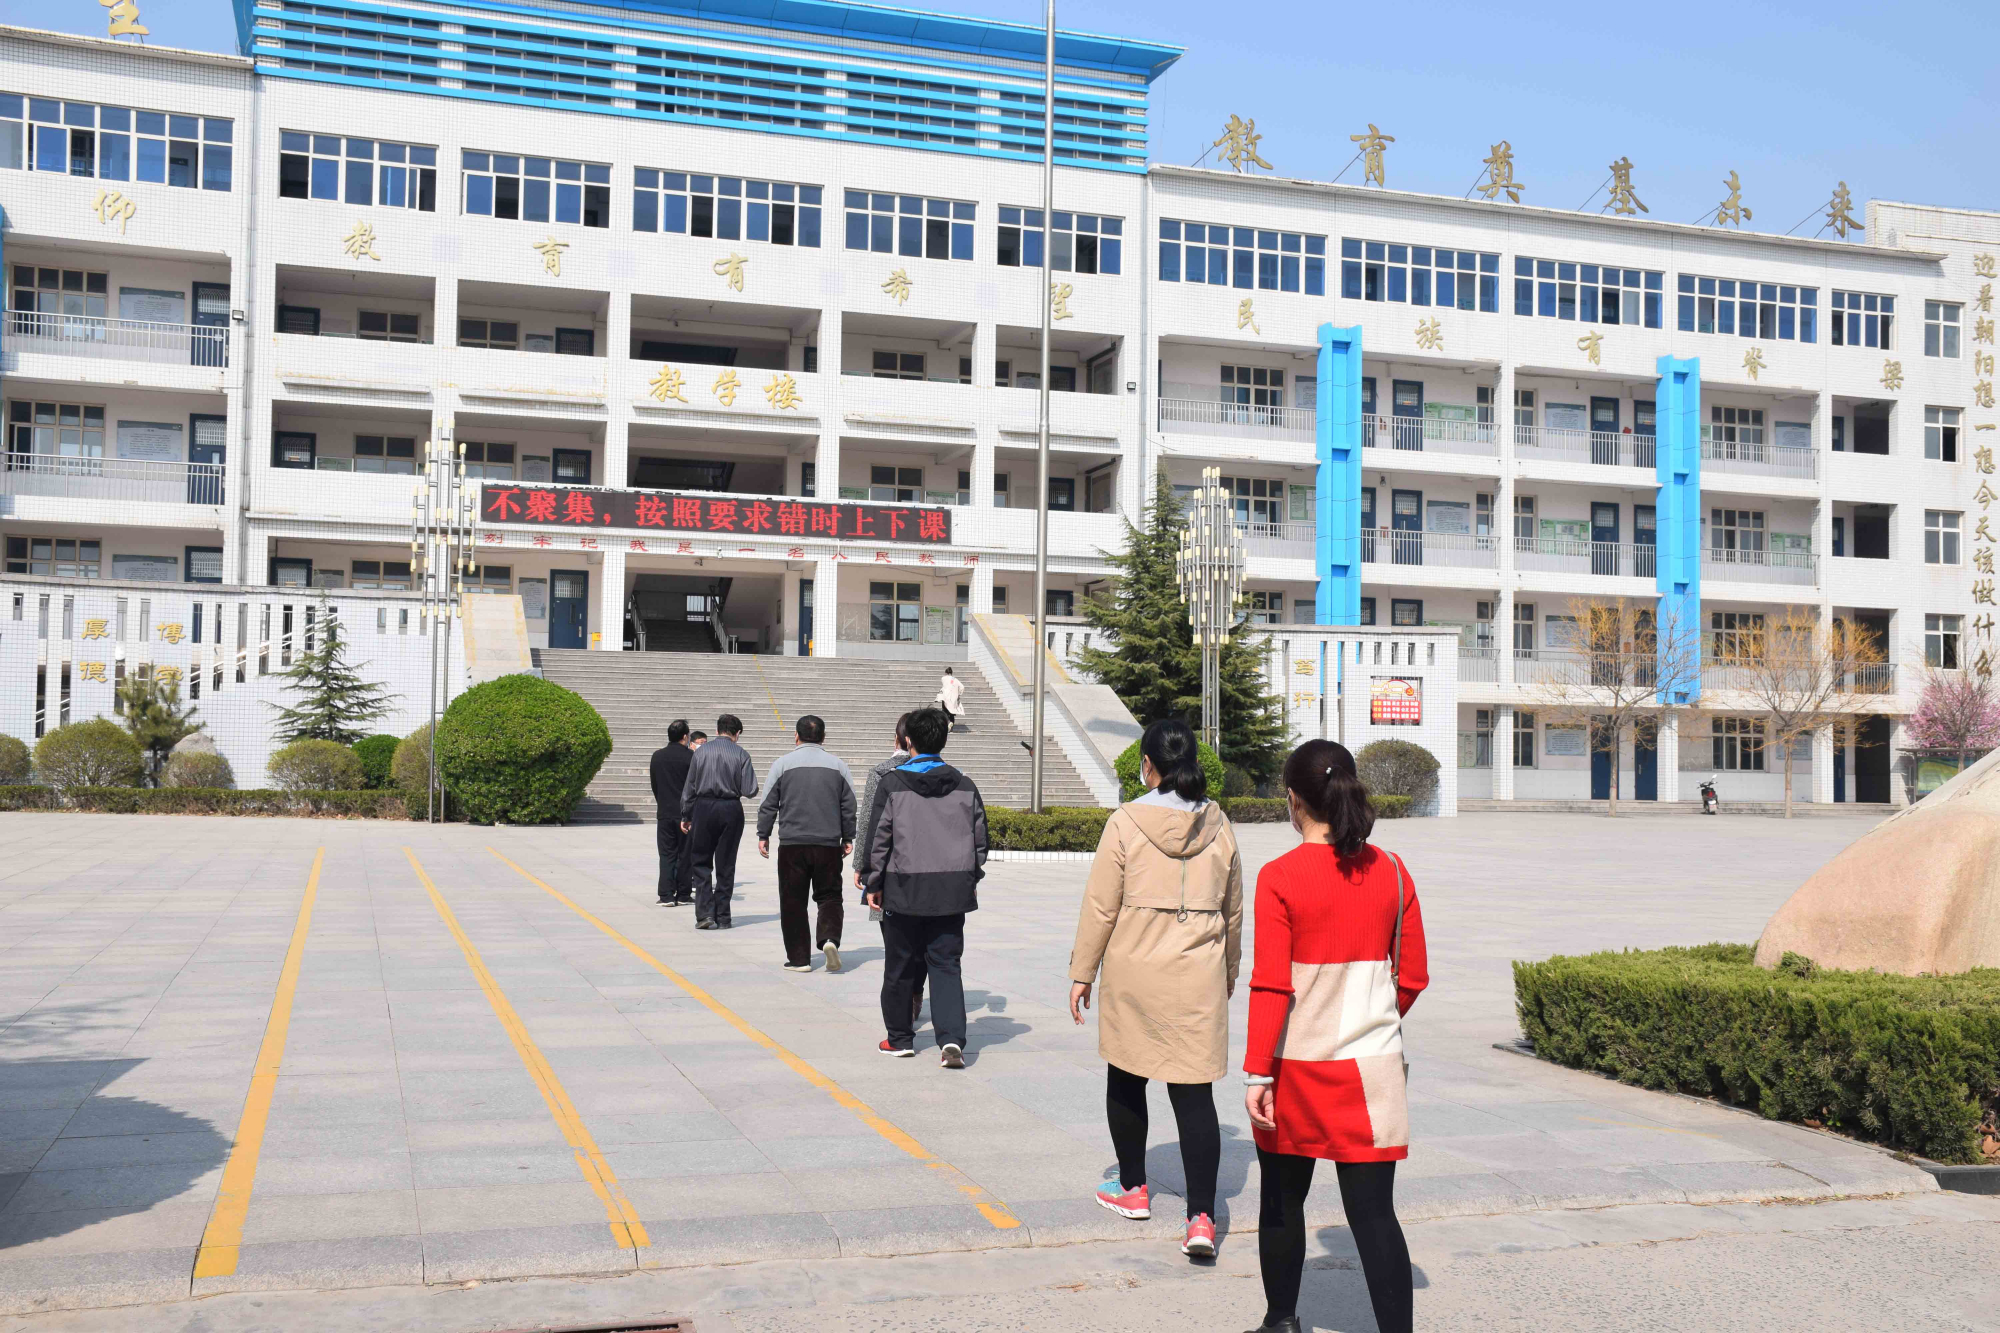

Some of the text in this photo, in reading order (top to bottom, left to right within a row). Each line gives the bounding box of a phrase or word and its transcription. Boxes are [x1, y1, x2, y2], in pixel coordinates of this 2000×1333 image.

[1213, 114, 1865, 239] 教育奠基未来
[342, 220, 1074, 320] 教育有希望
[1237, 298, 1905, 392] 民族有脊梁
[649, 365, 803, 411] 教学楼
[441, 534, 980, 566] 刻牢记我是一名人民教师
[80, 618, 110, 684] 厚德
[156, 622, 187, 685] 博学
